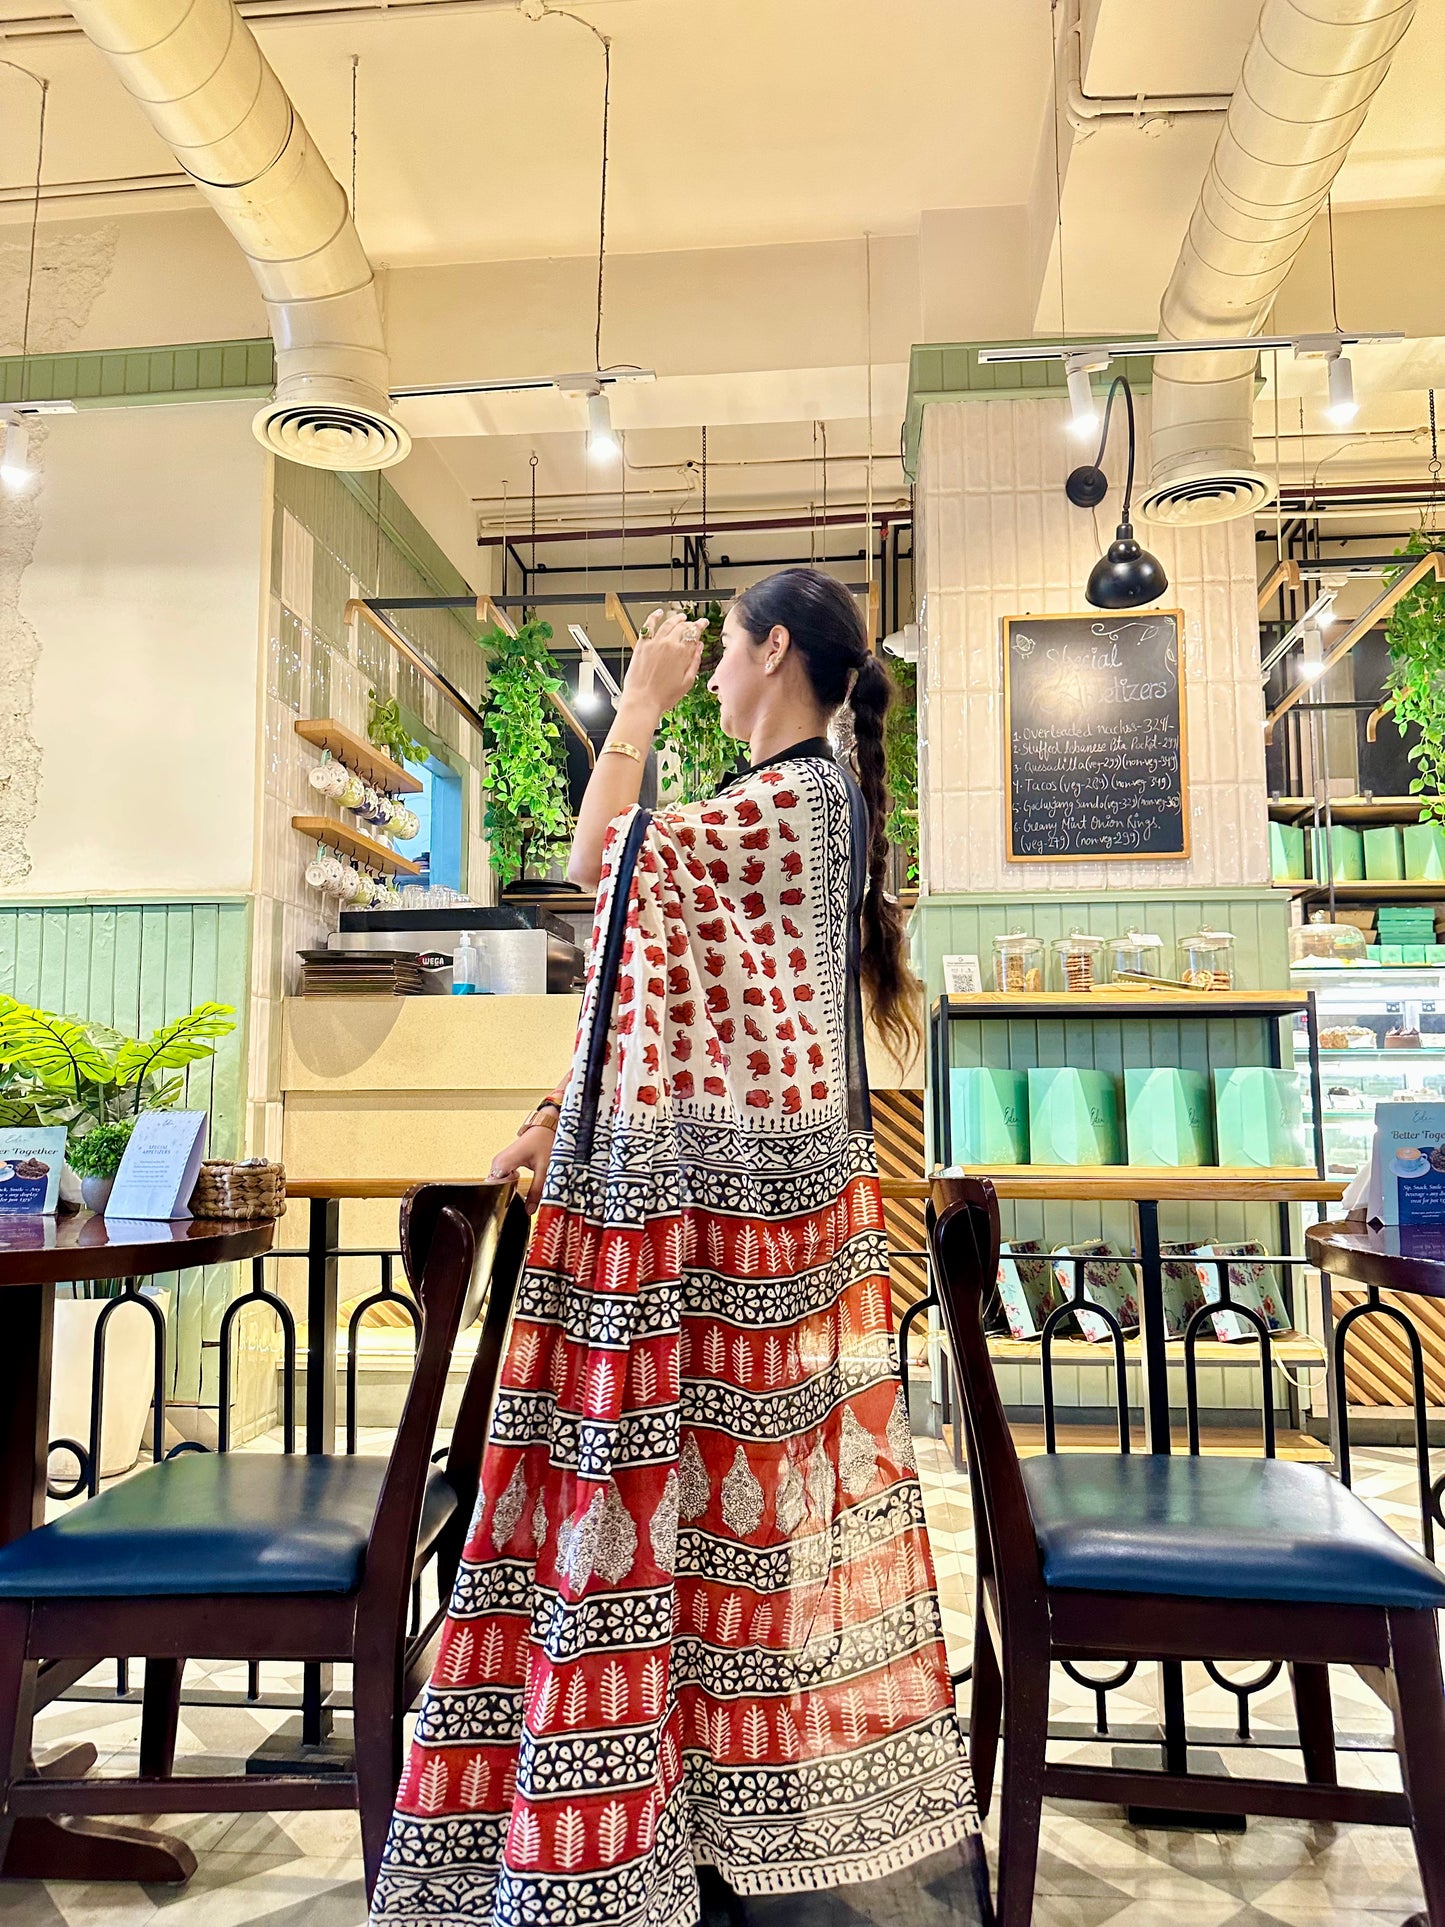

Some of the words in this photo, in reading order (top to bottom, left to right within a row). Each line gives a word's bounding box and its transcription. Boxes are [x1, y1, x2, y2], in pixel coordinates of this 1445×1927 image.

[1025, 778, 1057, 792] Tacos
[1061, 815, 1087, 829] Mint
[1090, 814, 1124, 830] Onion
[422, 957, 445, 967] WEGA
[1391, 1130, 1420, 1140] Better
[13, 1147, 59, 1157] Together
